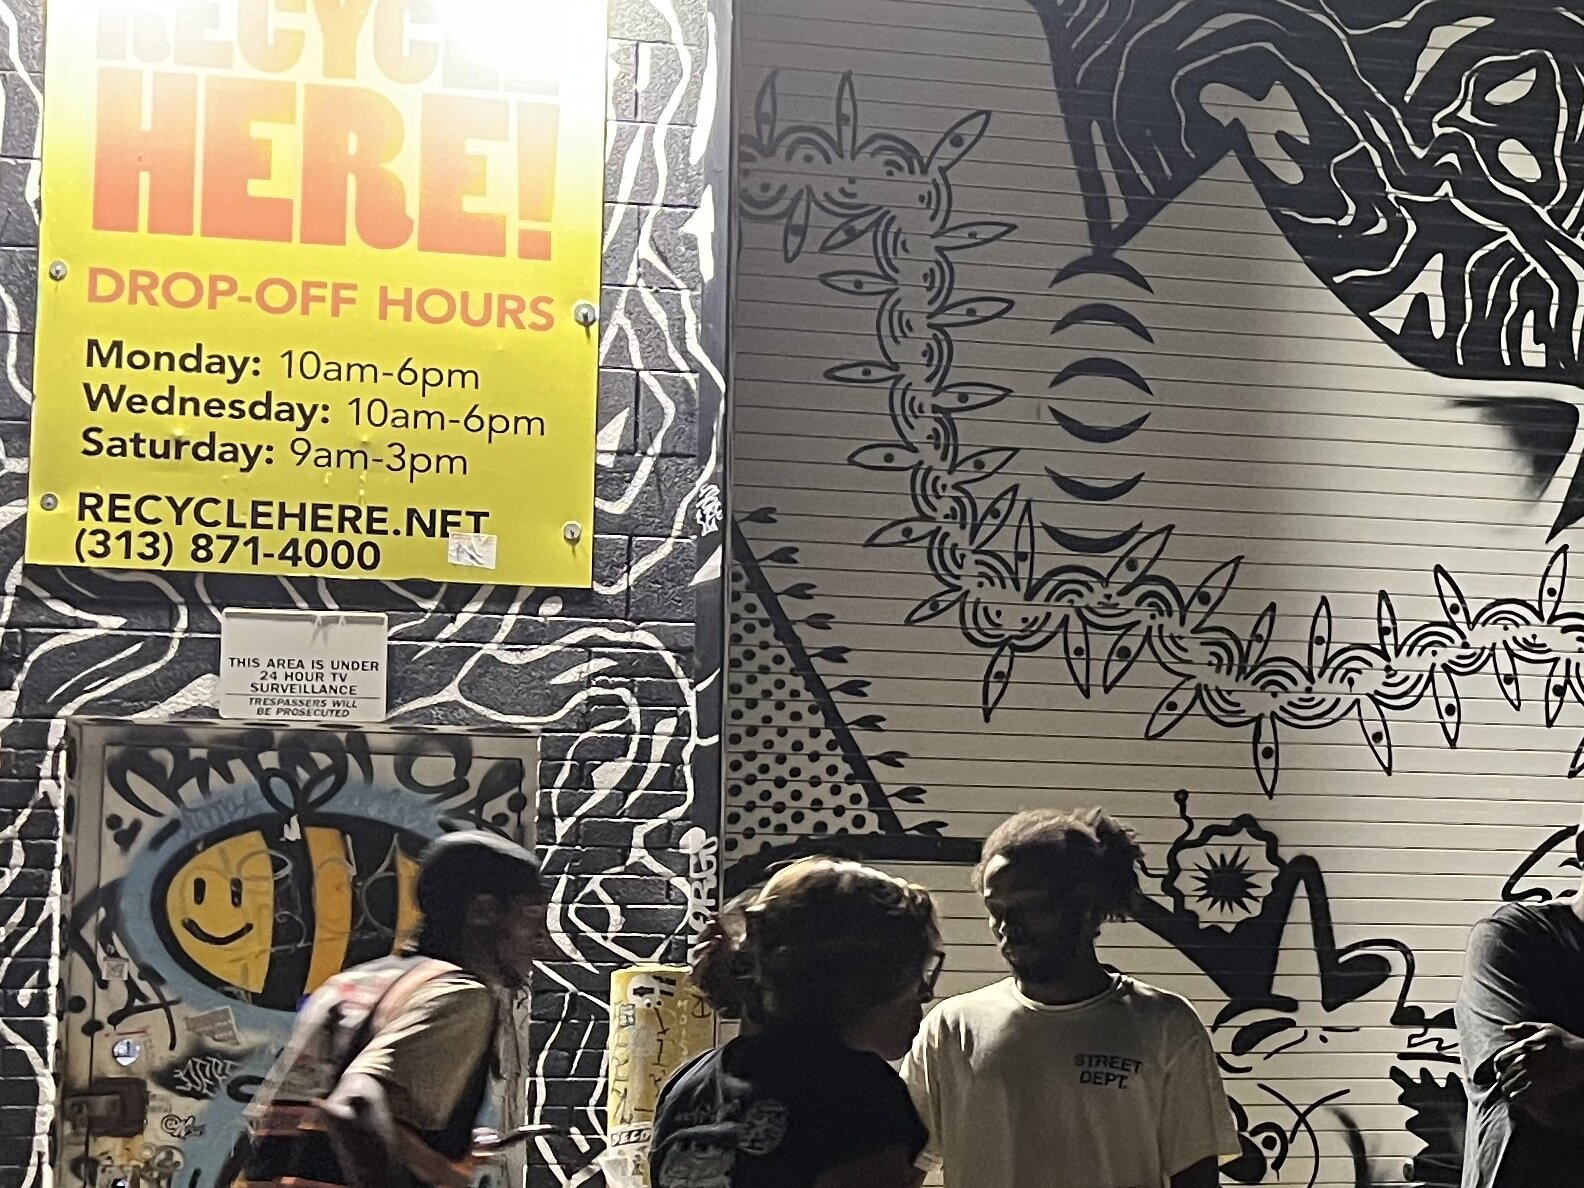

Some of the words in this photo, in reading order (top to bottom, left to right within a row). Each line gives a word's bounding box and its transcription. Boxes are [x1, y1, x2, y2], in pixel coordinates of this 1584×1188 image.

[96, 0, 560, 95] RECYCL
[92, 66, 560, 261] HERE!
[86, 266, 358, 317] DROP-OFF
[377, 284, 555, 332] HOURS
[85, 338, 262, 382] Monday:
[279, 349, 481, 398] 10am-6pm
[82, 381, 330, 431] Wednesday:
[346, 396, 547, 443] 10am-6pm
[80, 426, 275, 471] Saturday:
[289, 437, 469, 483] 9am-3pm
[77, 491, 490, 540] RECYCLEHERE.NET
[74, 529, 174, 568] (313)
[190, 535, 381, 571] 871-4000
[228, 657, 260, 669] THIS
[266, 658, 305, 670] AREA
[311, 659, 324, 671] IS
[331, 660, 380, 672] UNDER
[259, 670, 278, 682] 24
[284, 671, 325, 683] HOUR
[331, 673, 348, 683] TV
[249, 697, 327, 708] TRESPASSERS
[332, 699, 358, 709] WILL
[250, 682, 358, 695] SURVEILLANCE
[256, 707, 272, 717] BE
[275, 708, 350, 718] PROSECUTED
[1074, 1053, 1144, 1075] STREET
[1080, 1070, 1129, 1090] DEPT.
